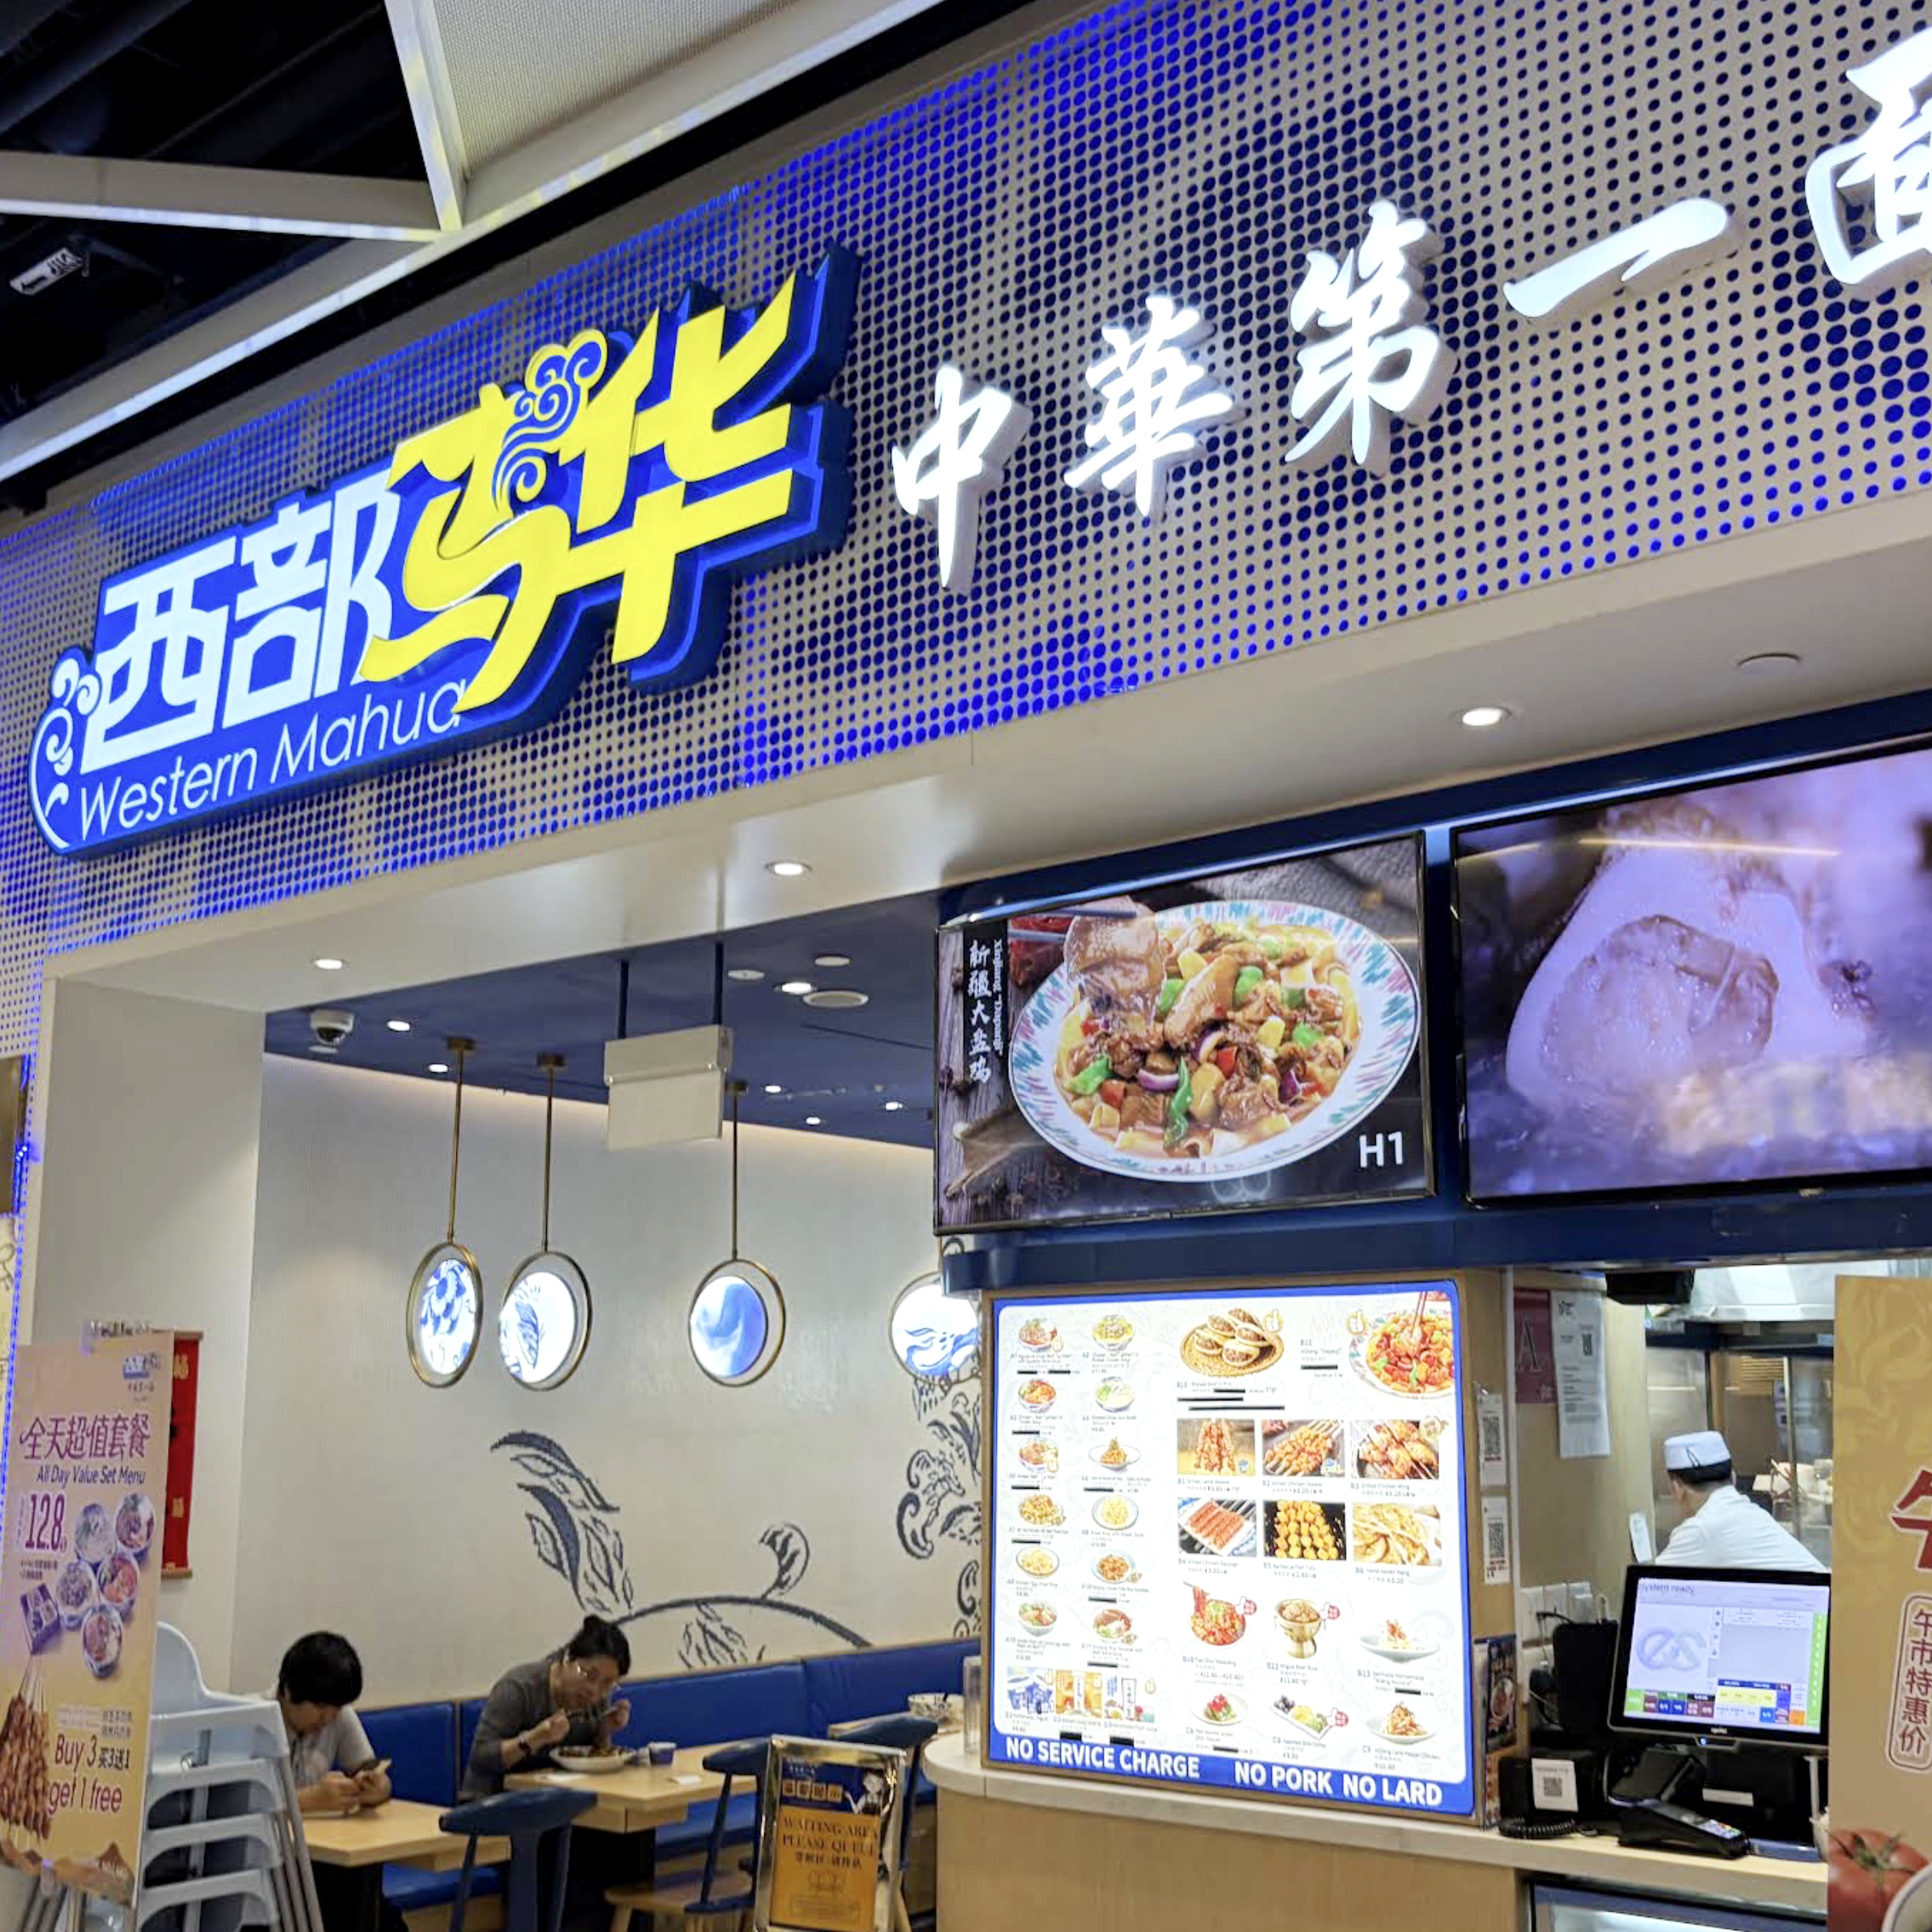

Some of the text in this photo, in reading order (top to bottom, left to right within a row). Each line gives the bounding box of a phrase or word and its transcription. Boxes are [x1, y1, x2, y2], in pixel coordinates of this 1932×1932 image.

[80, 678, 464, 842] Western Mahua
[1358, 1131, 1404, 1169] H1
[19, 1413, 151, 1461] 全天超值套餐
[36, 1464, 147, 1489] All Day Value Set Menu
[54, 1733, 97, 1773] Buy 3
[1006, 1736, 1200, 1779] NO SERVICE CHARGE
[48, 1776, 76, 1816] get
[89, 1777, 122, 1814] free
[1234, 1760, 1443, 1806] NO PORK NO LARD
